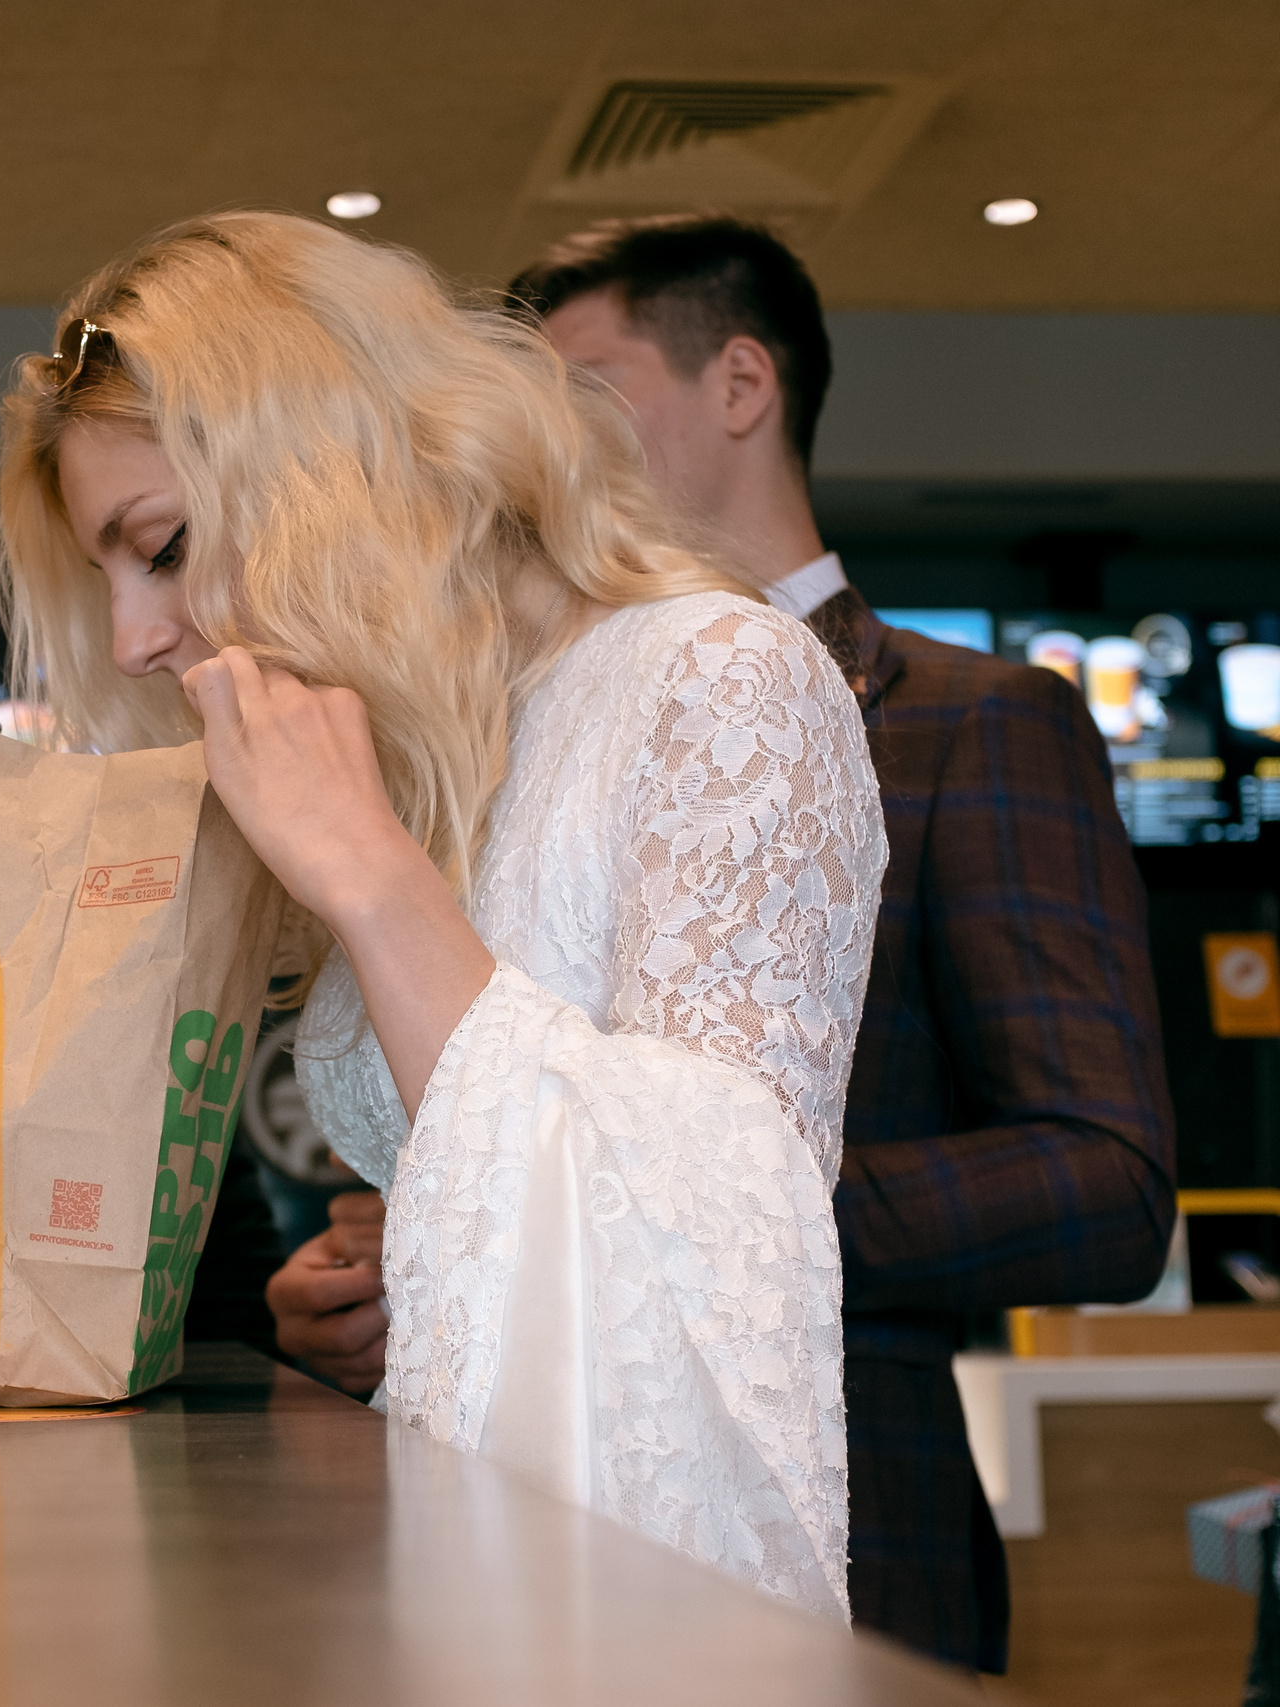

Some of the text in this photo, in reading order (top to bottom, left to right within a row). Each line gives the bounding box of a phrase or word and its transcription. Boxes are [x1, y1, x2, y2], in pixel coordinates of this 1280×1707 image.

[87, 891, 107, 900] FSC
[111, 892, 129, 902] FSC
[135, 887, 172, 899] C123189
[29, 1233, 114, 1251] ВОТЧТОЯСКАЖУ.РФ
